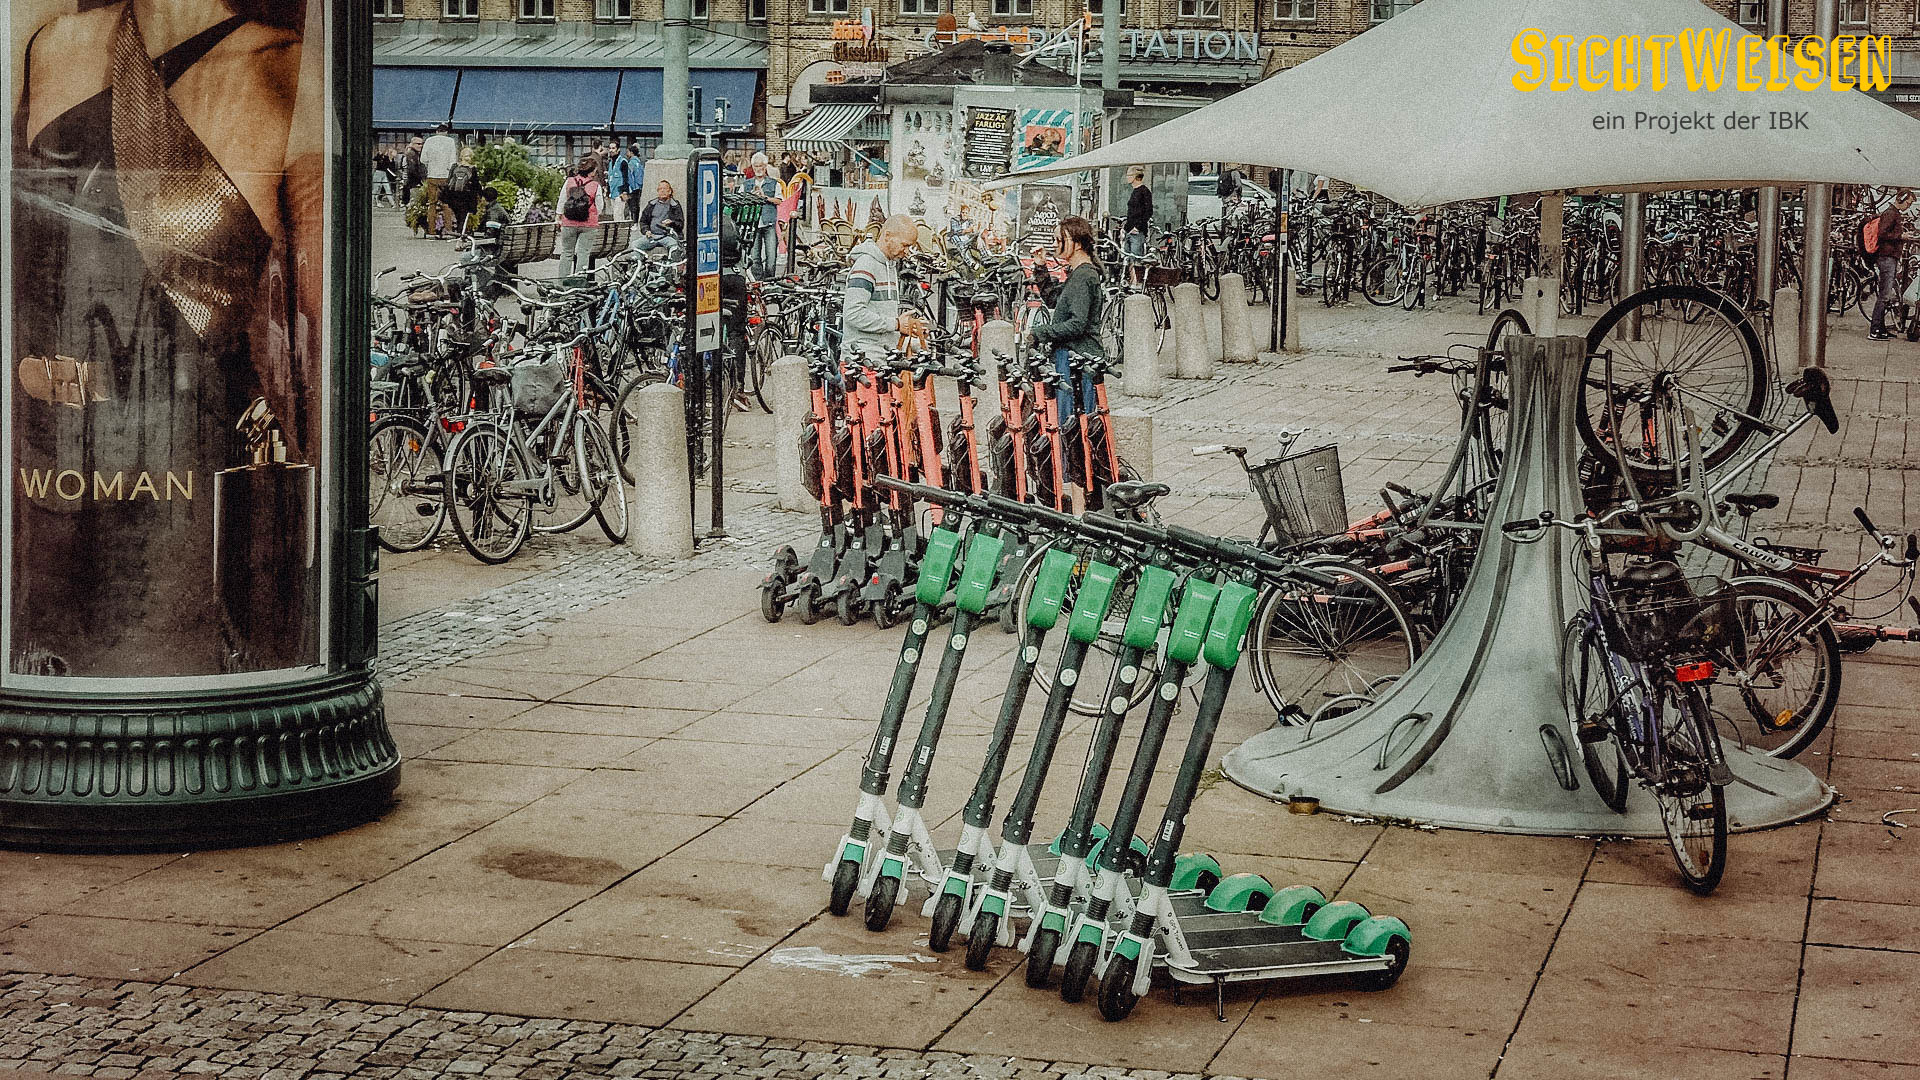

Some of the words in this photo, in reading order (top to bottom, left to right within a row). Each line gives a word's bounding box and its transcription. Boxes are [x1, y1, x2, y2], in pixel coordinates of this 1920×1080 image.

[975, 112, 995, 121] JAZZ
[975, 120, 1006, 130] FARLIGT
[702, 169, 716, 228] P
[20, 468, 194, 501] WOMAN
[1733, 542, 1778, 565] CALVIN
